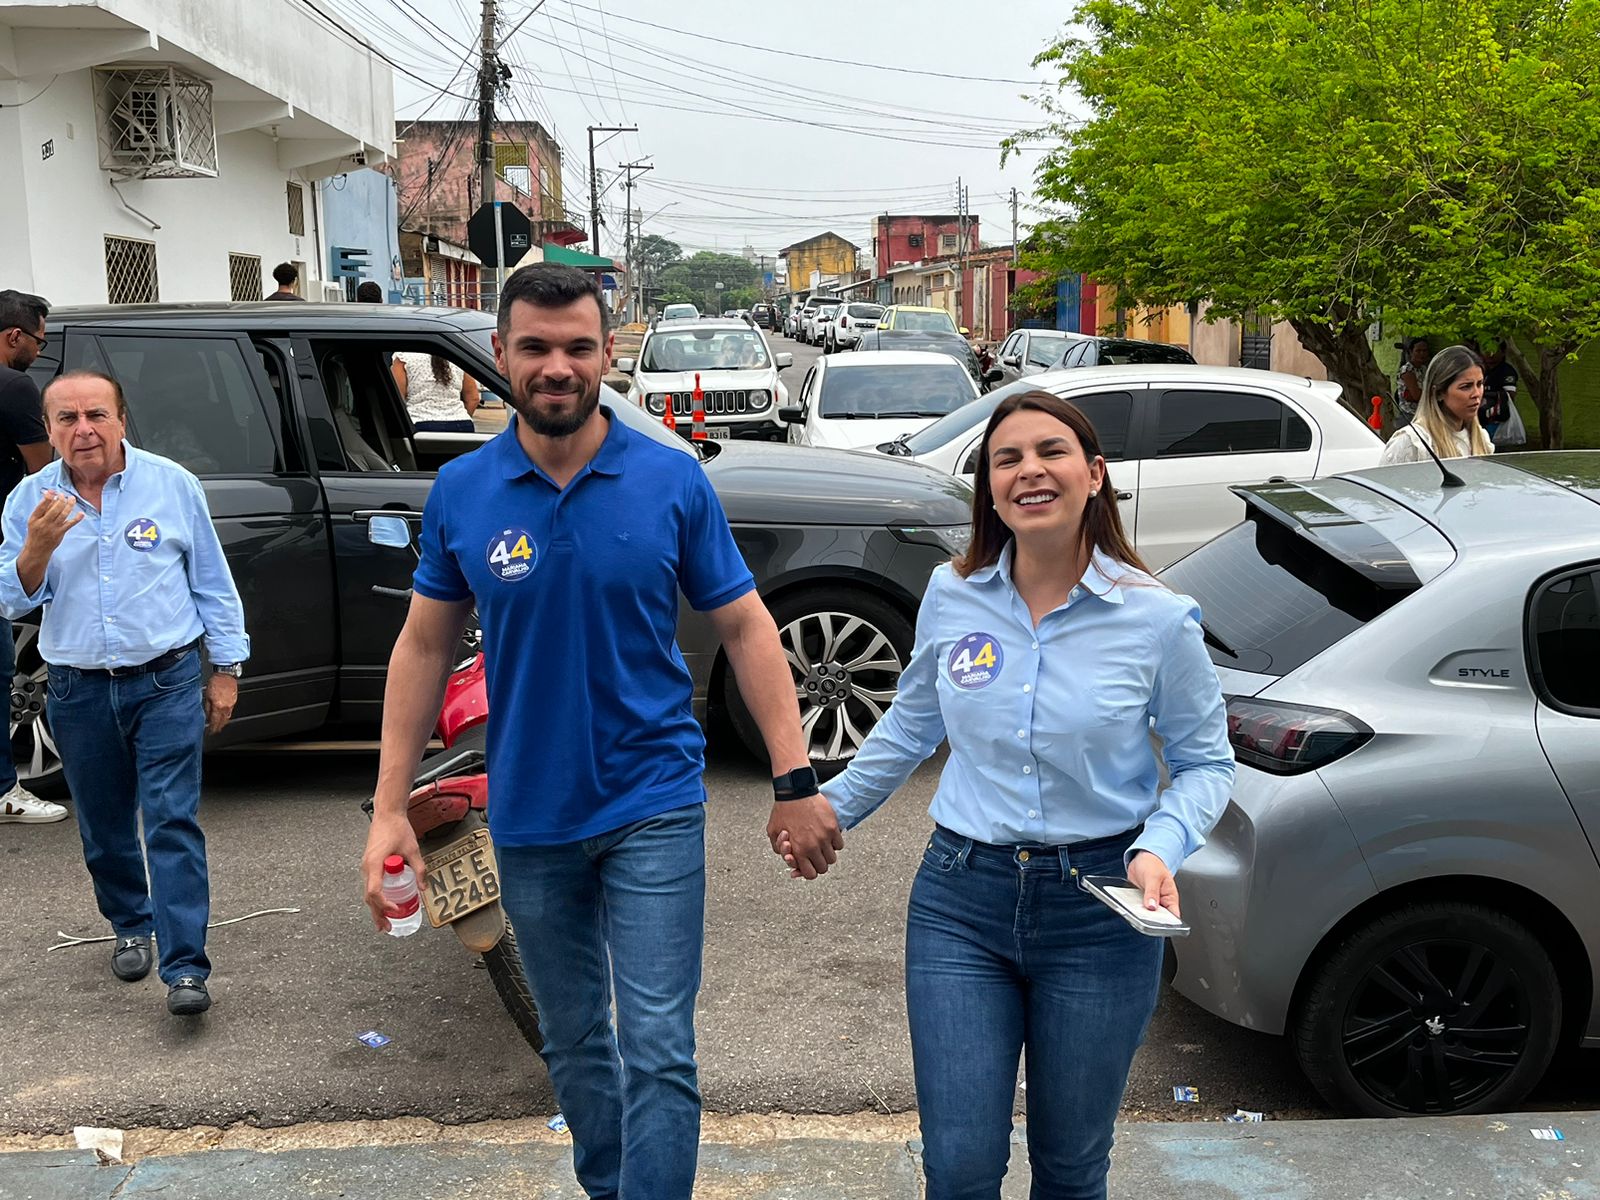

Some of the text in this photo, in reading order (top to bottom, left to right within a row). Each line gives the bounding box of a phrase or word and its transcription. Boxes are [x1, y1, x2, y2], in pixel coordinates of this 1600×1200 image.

[127, 524, 158, 541] 44
[489, 535, 533, 565] 44
[951, 642, 997, 673] 44
[1458, 668, 1510, 678] STYLE
[427, 848, 490, 897] NEE
[433, 871, 499, 920] 2248
